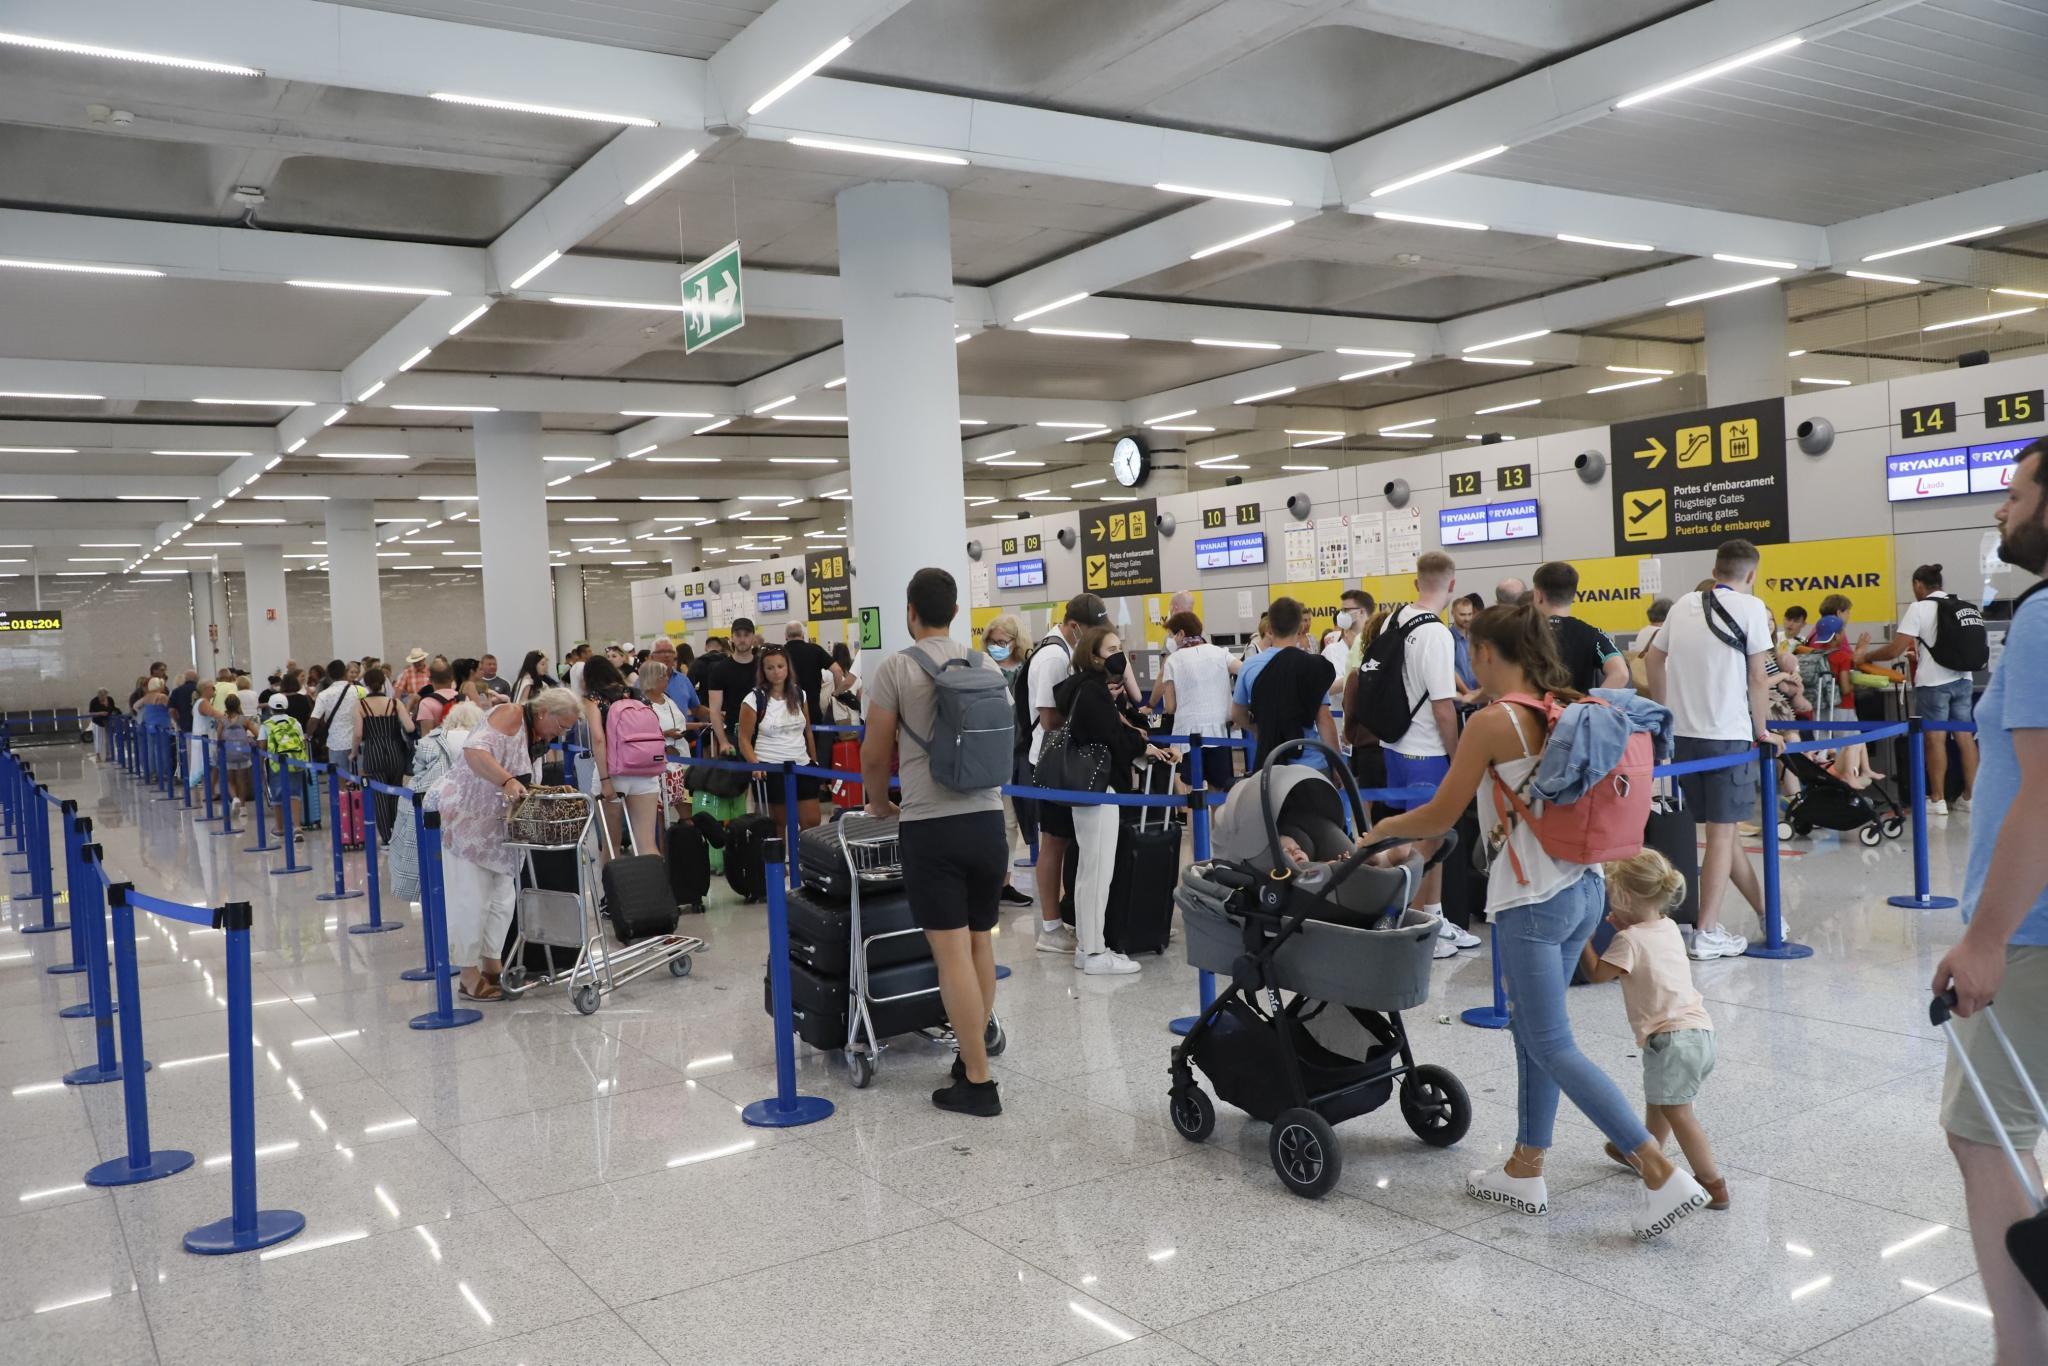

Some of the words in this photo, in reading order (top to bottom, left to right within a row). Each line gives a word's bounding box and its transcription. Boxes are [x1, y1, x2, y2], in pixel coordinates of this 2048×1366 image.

[1997, 396, 2031, 422] 15
[1912, 408, 1944, 433] 14
[1899, 454, 1966, 472] RYANAIR
[1456, 475, 1474, 493] 12
[1504, 468, 1523, 487] 13
[1673, 485, 1701, 496] Portes
[1703, 475, 1775, 492] d'embarcament
[1674, 497, 1717, 509] Flugsteige
[1719, 494, 1745, 505] Gates
[1208, 511, 1221, 526] 10
[1241, 506, 1255, 522] 11
[1447, 511, 1486, 523] RYANAIR
[1494, 505, 1536, 518] RYANAIR
[1675, 510, 1713, 523] Boarding
[1715, 508, 1739, 521] gates
[1675, 525, 1709, 535] Puertas
[1711, 522, 1722, 532] de
[1725, 519, 1771, 531] embarque
[1004, 540, 1015, 552] 08
[1027, 537, 1038, 549] 09
[1780, 573, 1880, 592] RYANAIR
[1573, 587, 1641, 603] YANAIR
[1408, 616, 1423, 627] NIKE
